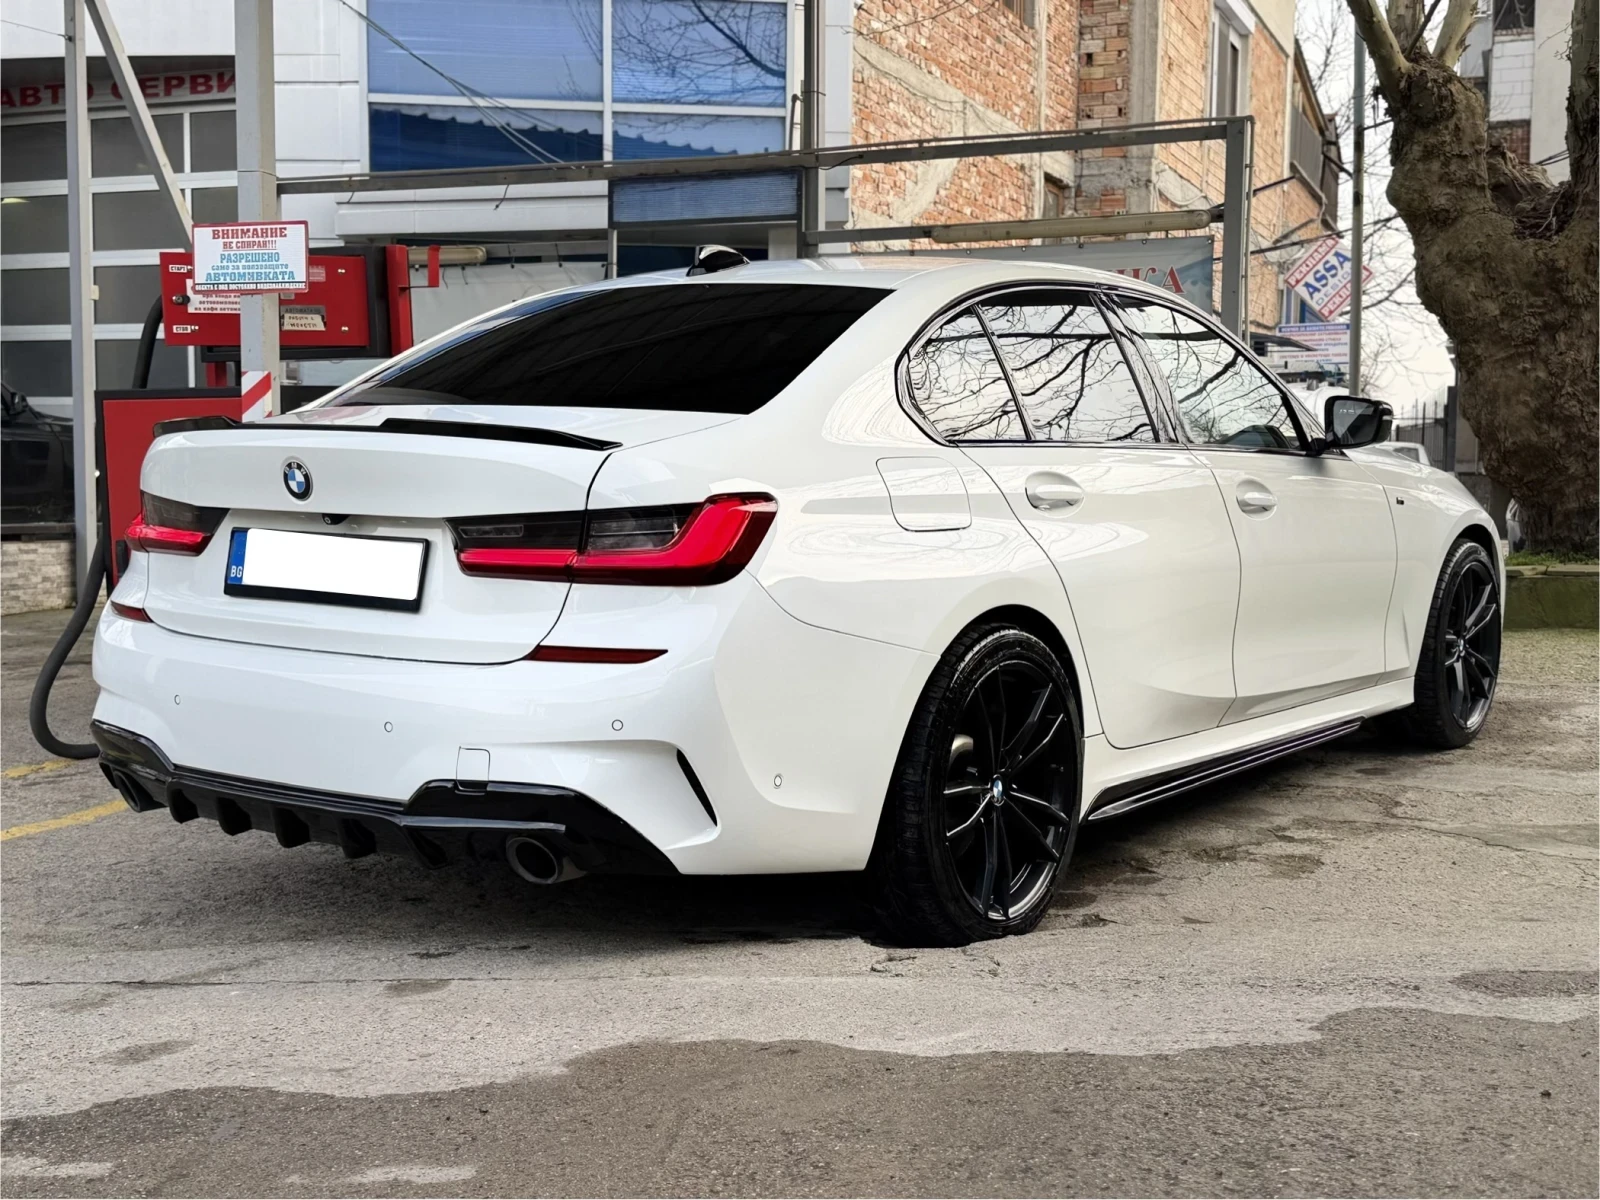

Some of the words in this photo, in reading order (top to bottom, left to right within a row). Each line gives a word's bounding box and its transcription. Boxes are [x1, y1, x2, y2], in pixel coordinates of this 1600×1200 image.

[0, 83, 94, 107] АВТ
[111, 72, 236, 99] СЕРВИ
[212, 227, 287, 240] ВНИМАНИЕ
[223, 241, 234, 250] НЕ
[220, 252, 280, 264] РАЗРЕШЕНО
[1287, 239, 1336, 288] РЕКЛАМА
[205, 271, 296, 282] АВТОМИВКАТА
[1303, 250, 1352, 300] ASSA
[284, 462, 306, 475] BMW
[230, 565, 243, 578] BG
